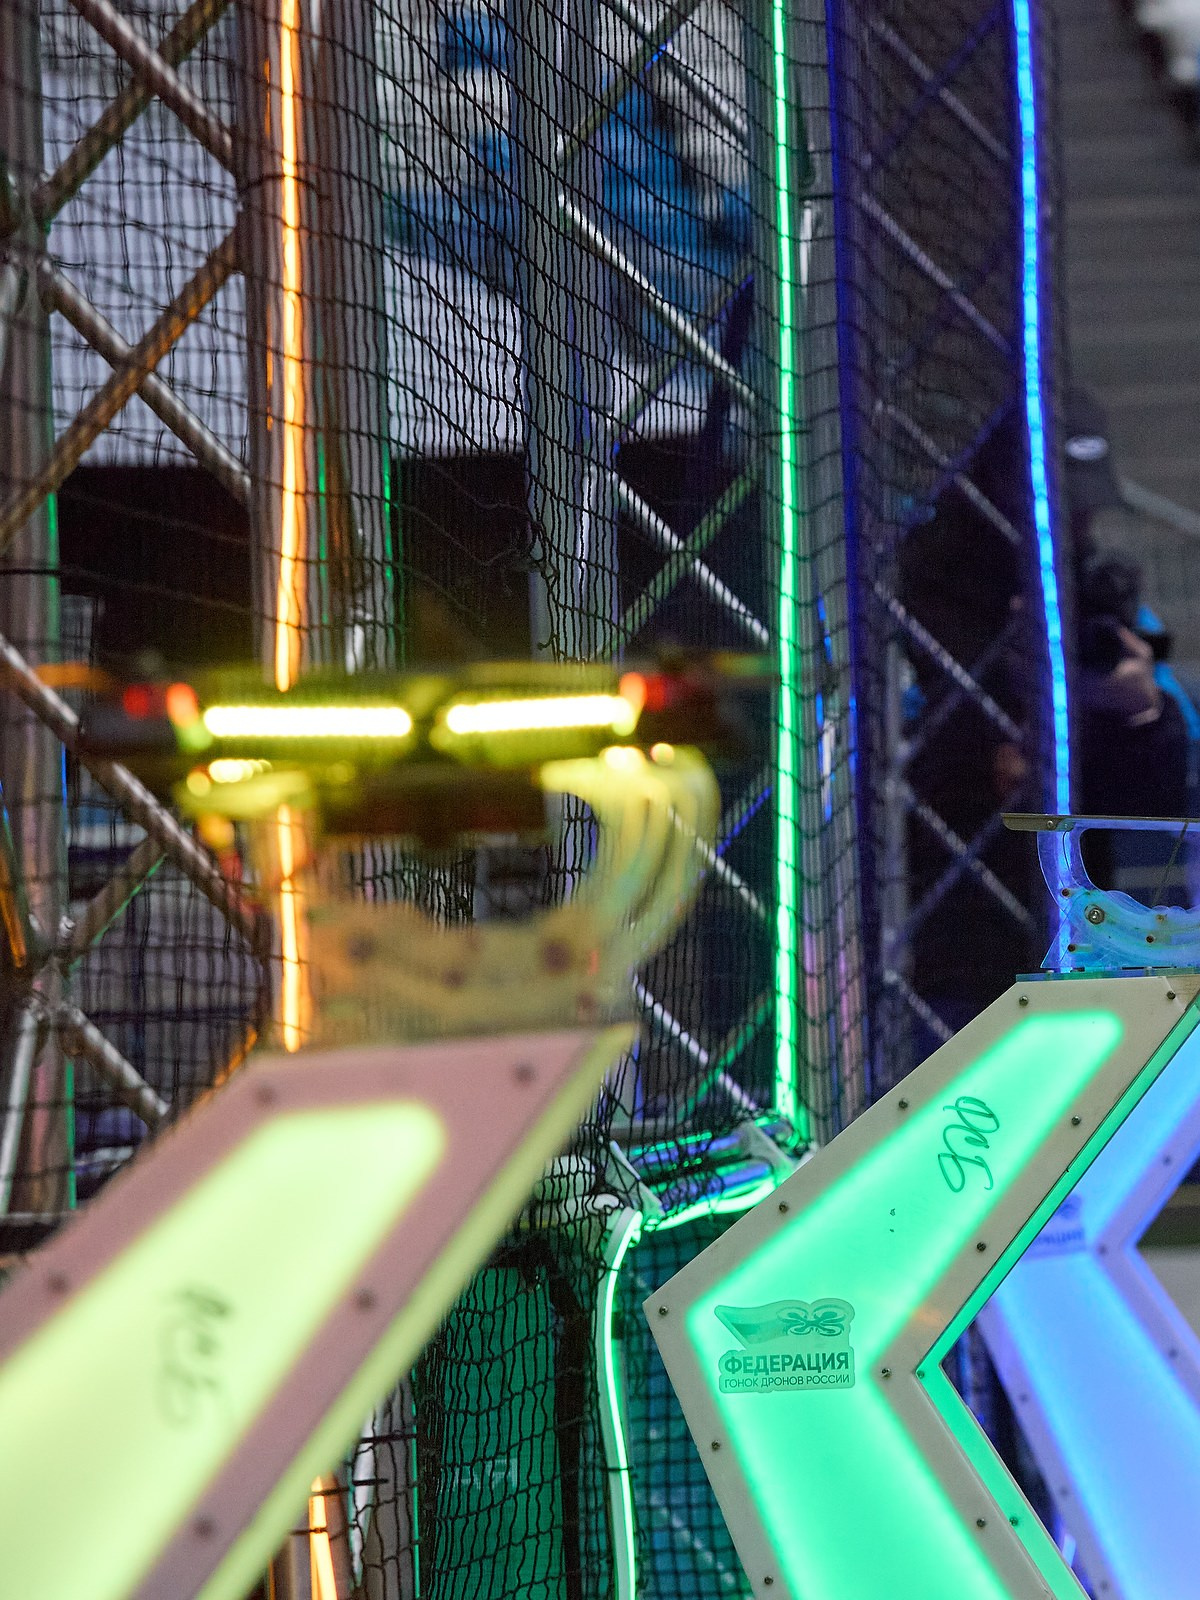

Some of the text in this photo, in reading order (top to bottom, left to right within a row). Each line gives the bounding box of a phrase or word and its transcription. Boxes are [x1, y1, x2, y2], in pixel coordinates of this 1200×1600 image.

[724, 1352, 849, 1376] ФЕДЕРАЦИЯ
[724, 1374, 850, 1388] ГОНОК ДРОНОВ РОССИИ
